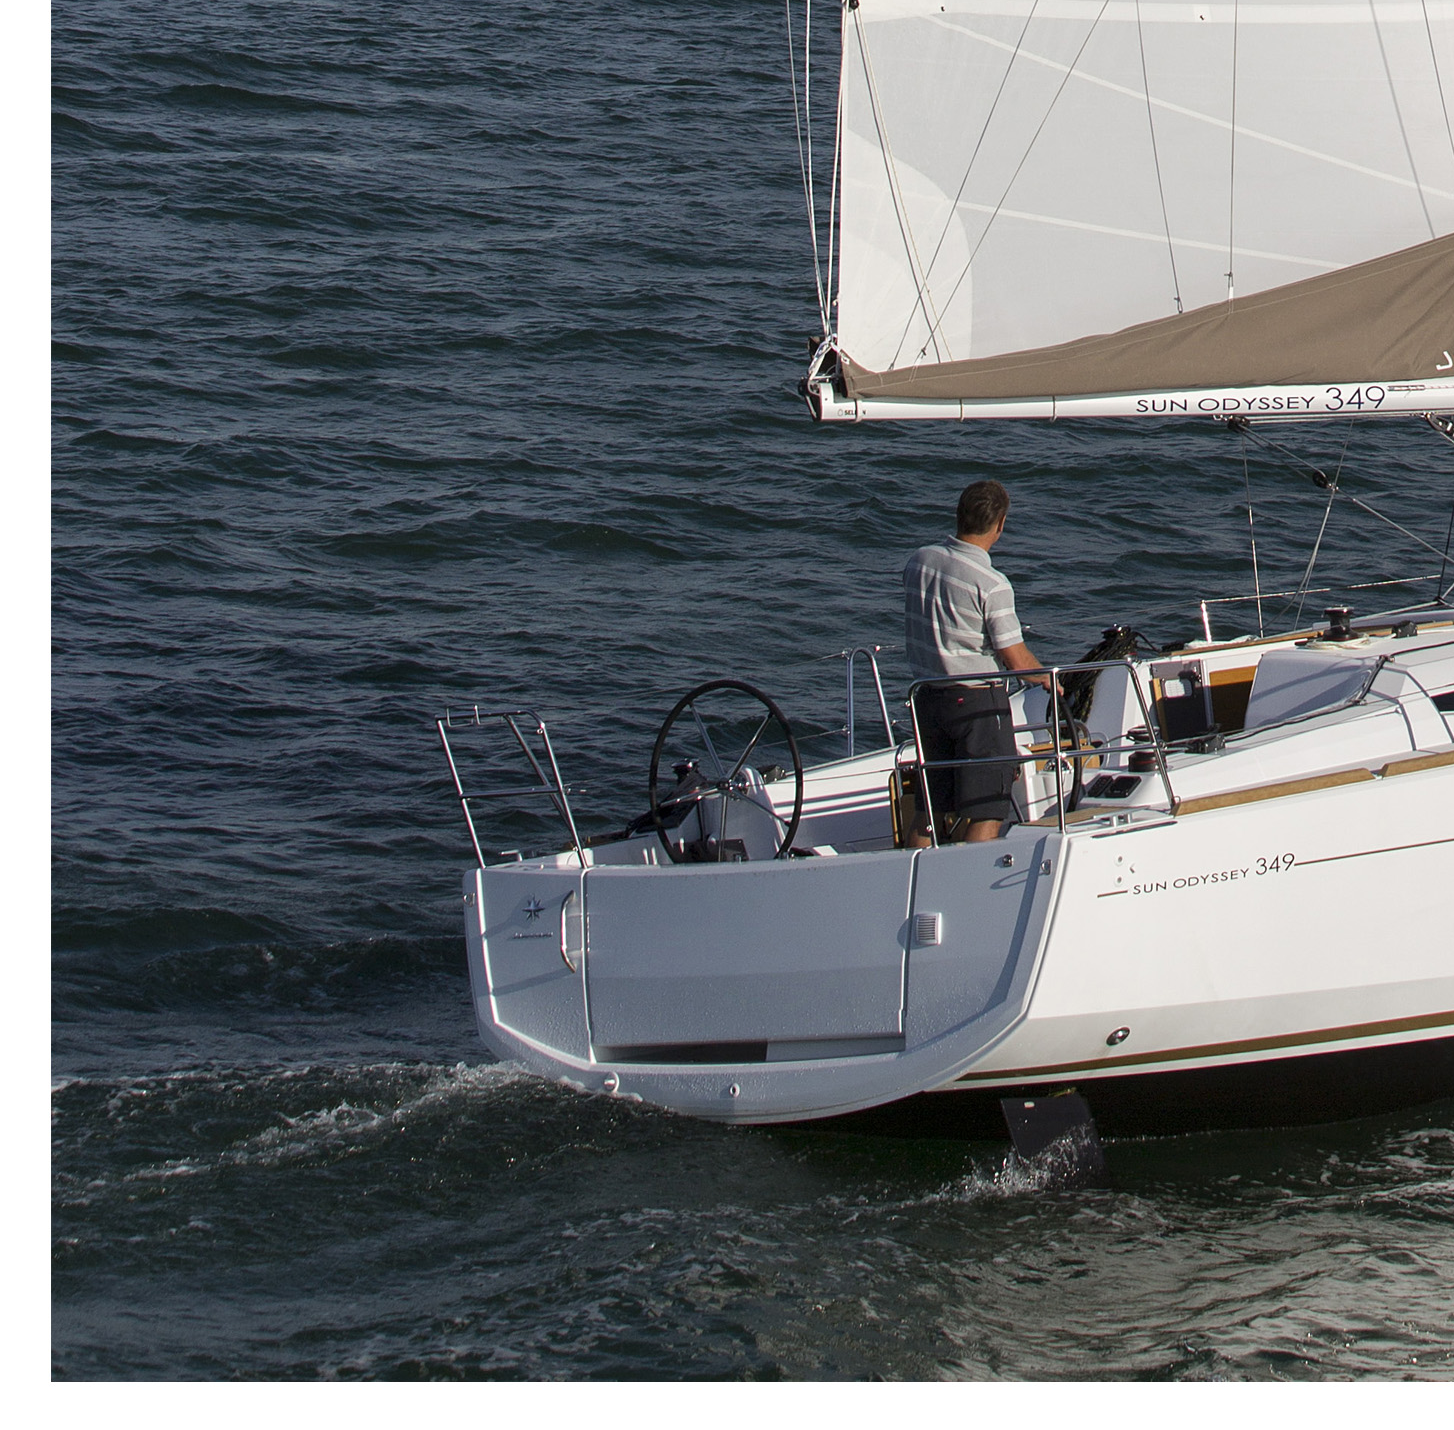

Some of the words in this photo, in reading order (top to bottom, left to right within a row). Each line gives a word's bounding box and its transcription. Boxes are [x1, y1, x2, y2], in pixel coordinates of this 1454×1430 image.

[1136, 398, 1188, 413] SUN
[1197, 396, 1316, 412] ODYSSEY
[1324, 385, 1386, 411] 349
[1132, 881, 1168, 895] SUN
[1172, 868, 1250, 889] ODYSSEY
[1255, 852, 1296, 876] 349
